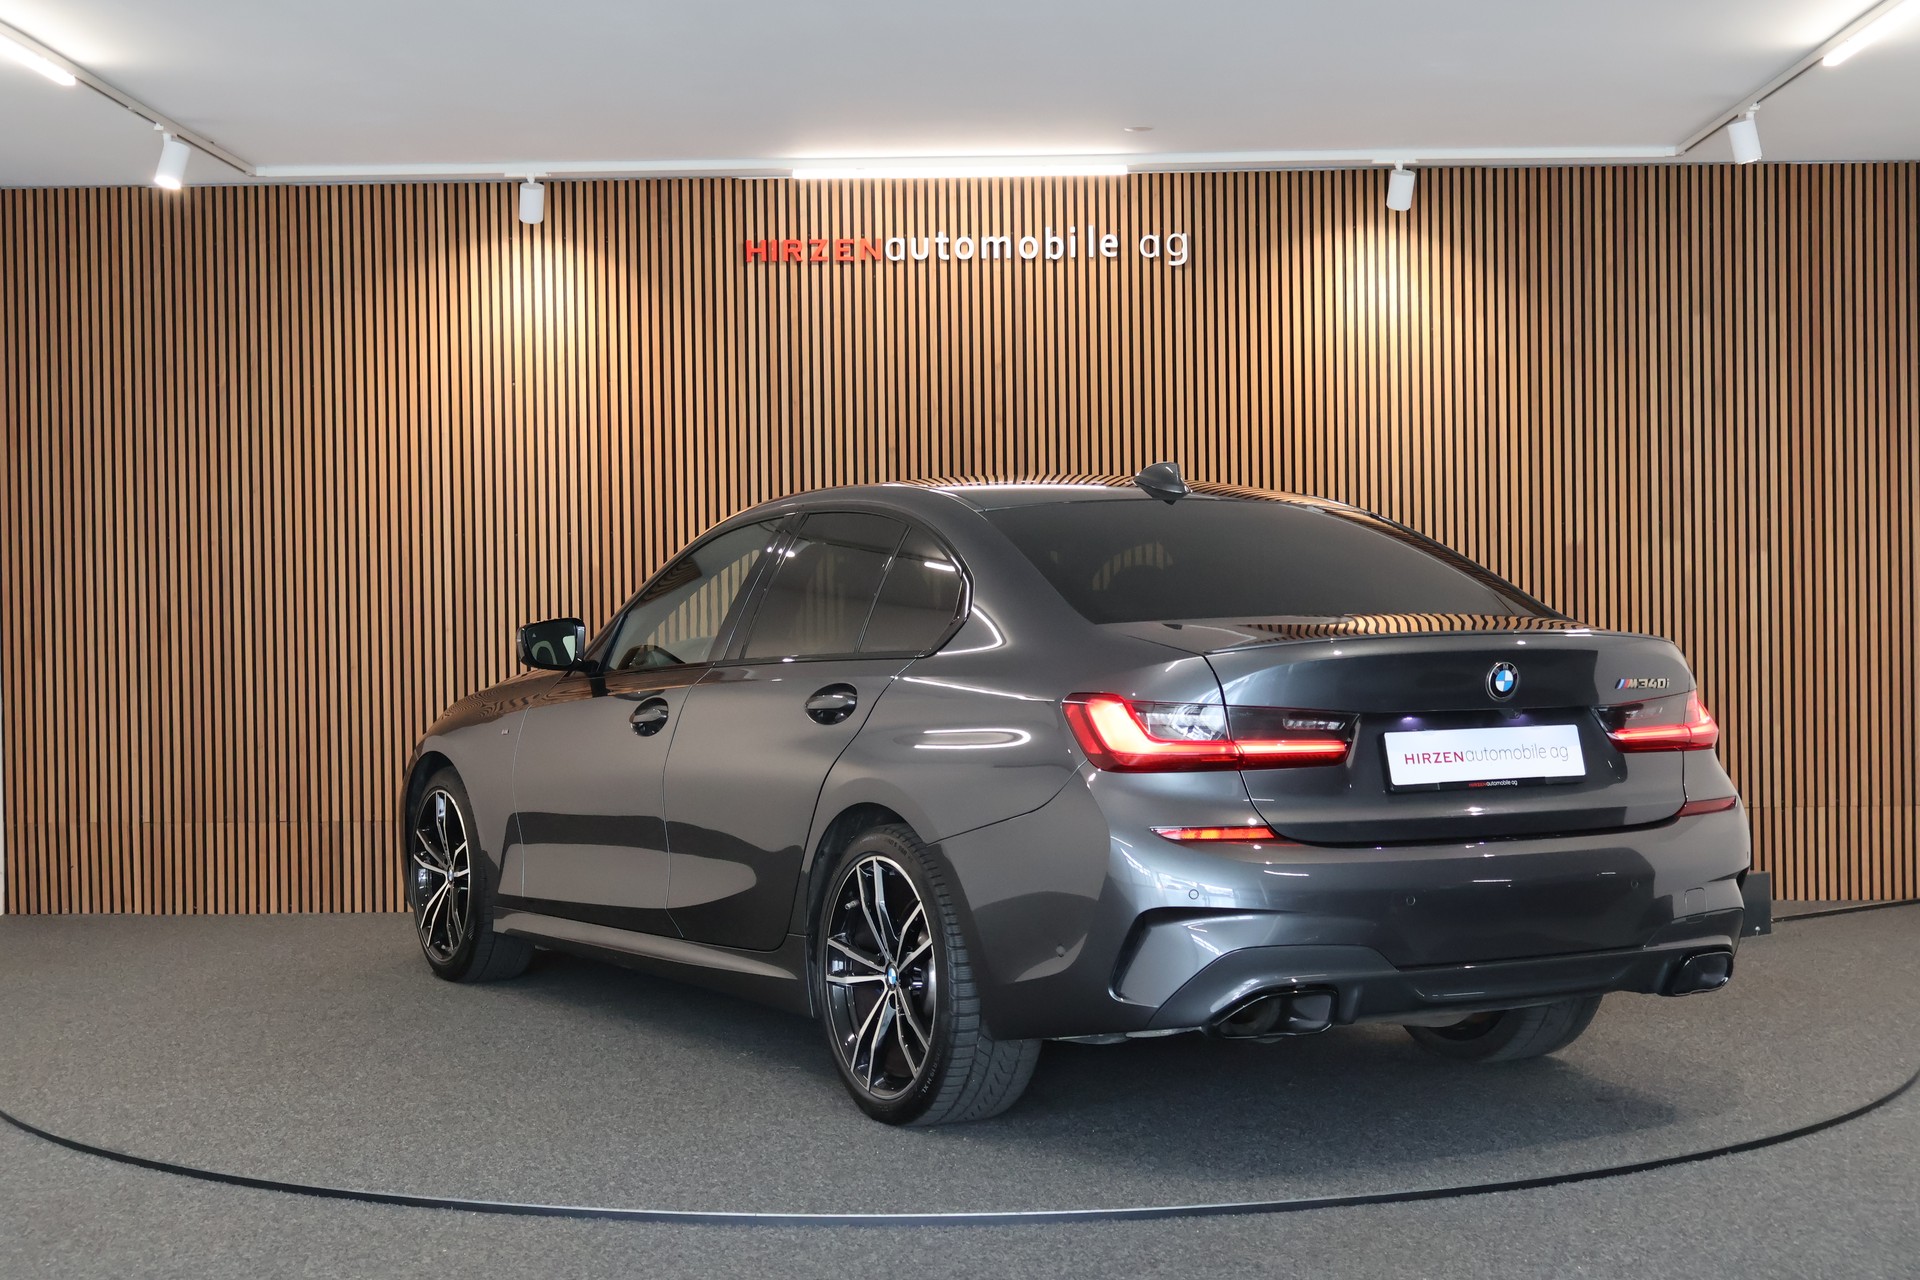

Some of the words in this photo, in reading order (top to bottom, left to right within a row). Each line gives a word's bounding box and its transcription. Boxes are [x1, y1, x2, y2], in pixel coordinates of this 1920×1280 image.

[746, 225, 1118, 262] HIRZENautomobile
[1139, 232, 1188, 266] ag
[1625, 678, 1670, 689] M340i
[1404, 743, 1547, 765] HIRZENautomobile
[1550, 746, 1569, 762] ag
